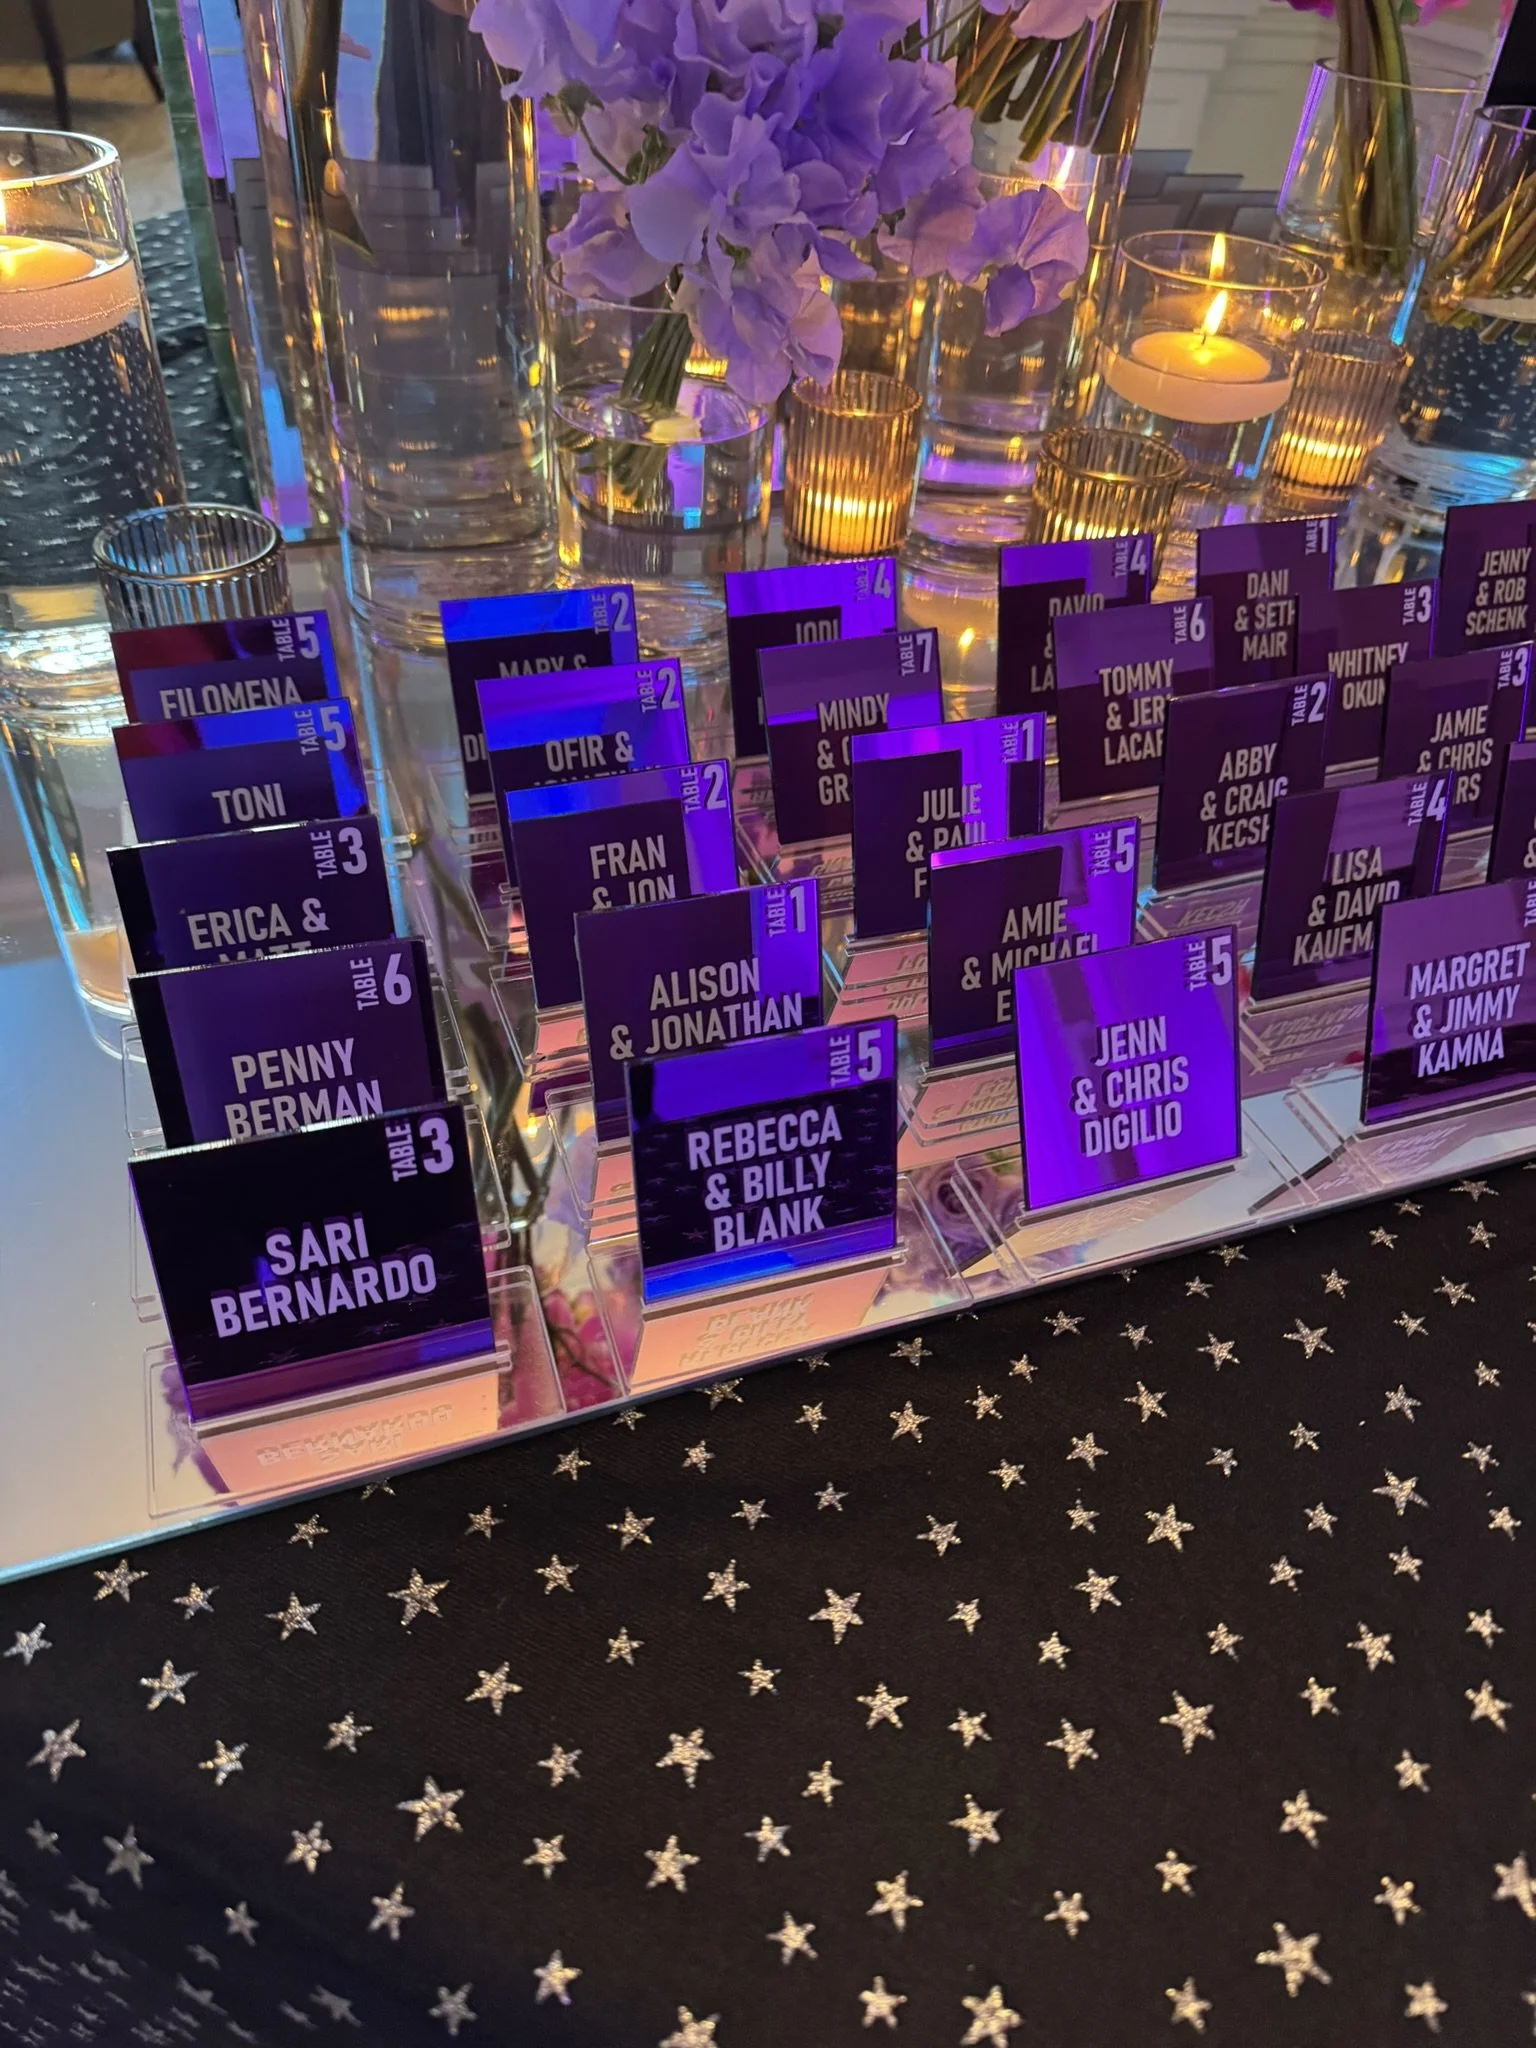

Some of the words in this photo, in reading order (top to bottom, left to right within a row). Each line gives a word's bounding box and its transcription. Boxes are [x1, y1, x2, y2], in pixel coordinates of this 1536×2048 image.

[1115, 541, 1129, 578] TABLE
[1130, 539, 1148, 576] 4
[1305, 519, 1318, 556] TABLE
[1319, 518, 1331, 554] 1
[855, 563, 870, 602] TABLE
[872, 562, 892, 600] 4
[1246, 568, 1289, 600] DANI
[1478, 547, 1532, 577] JENNY
[589, 592, 609, 635] TABLE
[610, 591, 632, 632] 2
[1403, 586, 1417, 626] TABLE
[1416, 585, 1432, 623] 3
[1475, 580, 1490, 607] &
[1493, 577, 1526, 605] ROB
[272, 617, 296, 662] TABLE
[295, 615, 321, 660] 5
[1174, 604, 1188, 645] TABLE
[1190, 602, 1206, 643] 6
[1234, 605, 1249, 632] &
[1465, 604, 1529, 637] SCHENK
[898, 634, 916, 677] TABLE
[916, 631, 934, 673] 7
[1242, 631, 1288, 662] MAIR
[1497, 649, 1513, 690] TABLE
[1512, 646, 1529, 687] 3
[636, 669, 658, 713] TABLE
[657, 667, 681, 711] 2
[1098, 658, 1174, 698] TOMMY
[816, 693, 890, 733] MINDY
[1105, 701, 1123, 731] &
[1128, 693, 1171, 728] JER
[1291, 683, 1309, 727] TABLE
[1308, 680, 1327, 724] 2
[1429, 705, 1489, 744] JAMIE
[294, 709, 320, 755] TABLE
[319, 705, 347, 751] 5
[544, 734, 606, 773] OFIR
[614, 730, 635, 763] &
[1001, 721, 1020, 764] TABLE
[1021, 719, 1034, 761] 1
[817, 739, 835, 771] &
[1218, 742, 1278, 783] ABBY
[1438, 737, 1494, 772] CHRIS
[211, 783, 287, 824] TONI
[680, 766, 700, 814] TABLE
[703, 764, 727, 811] 2
[916, 783, 982, 824] JULIE
[1200, 790, 1218, 822] &
[1407, 781, 1429, 827] TABLE
[1426, 778, 1447, 822] 4
[311, 829, 338, 880] TABLE
[338, 826, 368, 875] 3
[589, 834, 667, 880] FRAN
[905, 830, 925, 862] &
[1091, 829, 1112, 877] TABLE
[1113, 826, 1135, 873] 5
[1331, 845, 1383, 886] LISA
[187, 903, 293, 951] ERICA
[302, 897, 331, 934] &
[764, 886, 786, 938] TABLE
[788, 884, 806, 933] 1
[1002, 898, 1068, 944] AMIE
[1307, 894, 1326, 928] &
[1188, 940, 1206, 992] TABLE
[1211, 935, 1233, 987] 5
[1293, 920, 1374, 967] KAUFM
[349, 955, 379, 1011] TABLE
[383, 952, 413, 1006] 6
[649, 957, 760, 1011] ALISON
[961, 956, 982, 991] &
[1410, 940, 1532, 1001] MARGRET
[609, 1024, 635, 1060] &
[644, 992, 803, 1056] JONATHAN
[1412, 1003, 1433, 1041] &
[1439, 983, 1521, 1034] JIMMY
[830, 1034, 851, 1088] TABLE
[856, 1028, 883, 1082] 5
[1093, 1015, 1168, 1067] JENN
[1417, 1026, 1505, 1078] KAMNA
[231, 1037, 355, 1094] PENNY
[1074, 1077, 1096, 1116] &
[1105, 1055, 1189, 1108] CHRIS
[224, 1079, 384, 1140] BERMAN
[1085, 1099, 1182, 1158] DIGILIO
[387, 1118, 418, 1182] TABLE
[419, 1116, 455, 1175] 3
[687, 1105, 842, 1171] REBECCA
[703, 1172, 730, 1212] &
[743, 1151, 832, 1204] BILLY
[265, 1216, 370, 1276] SARI
[713, 1195, 826, 1253] BLANK
[211, 1253, 437, 1339] BERNARDO
